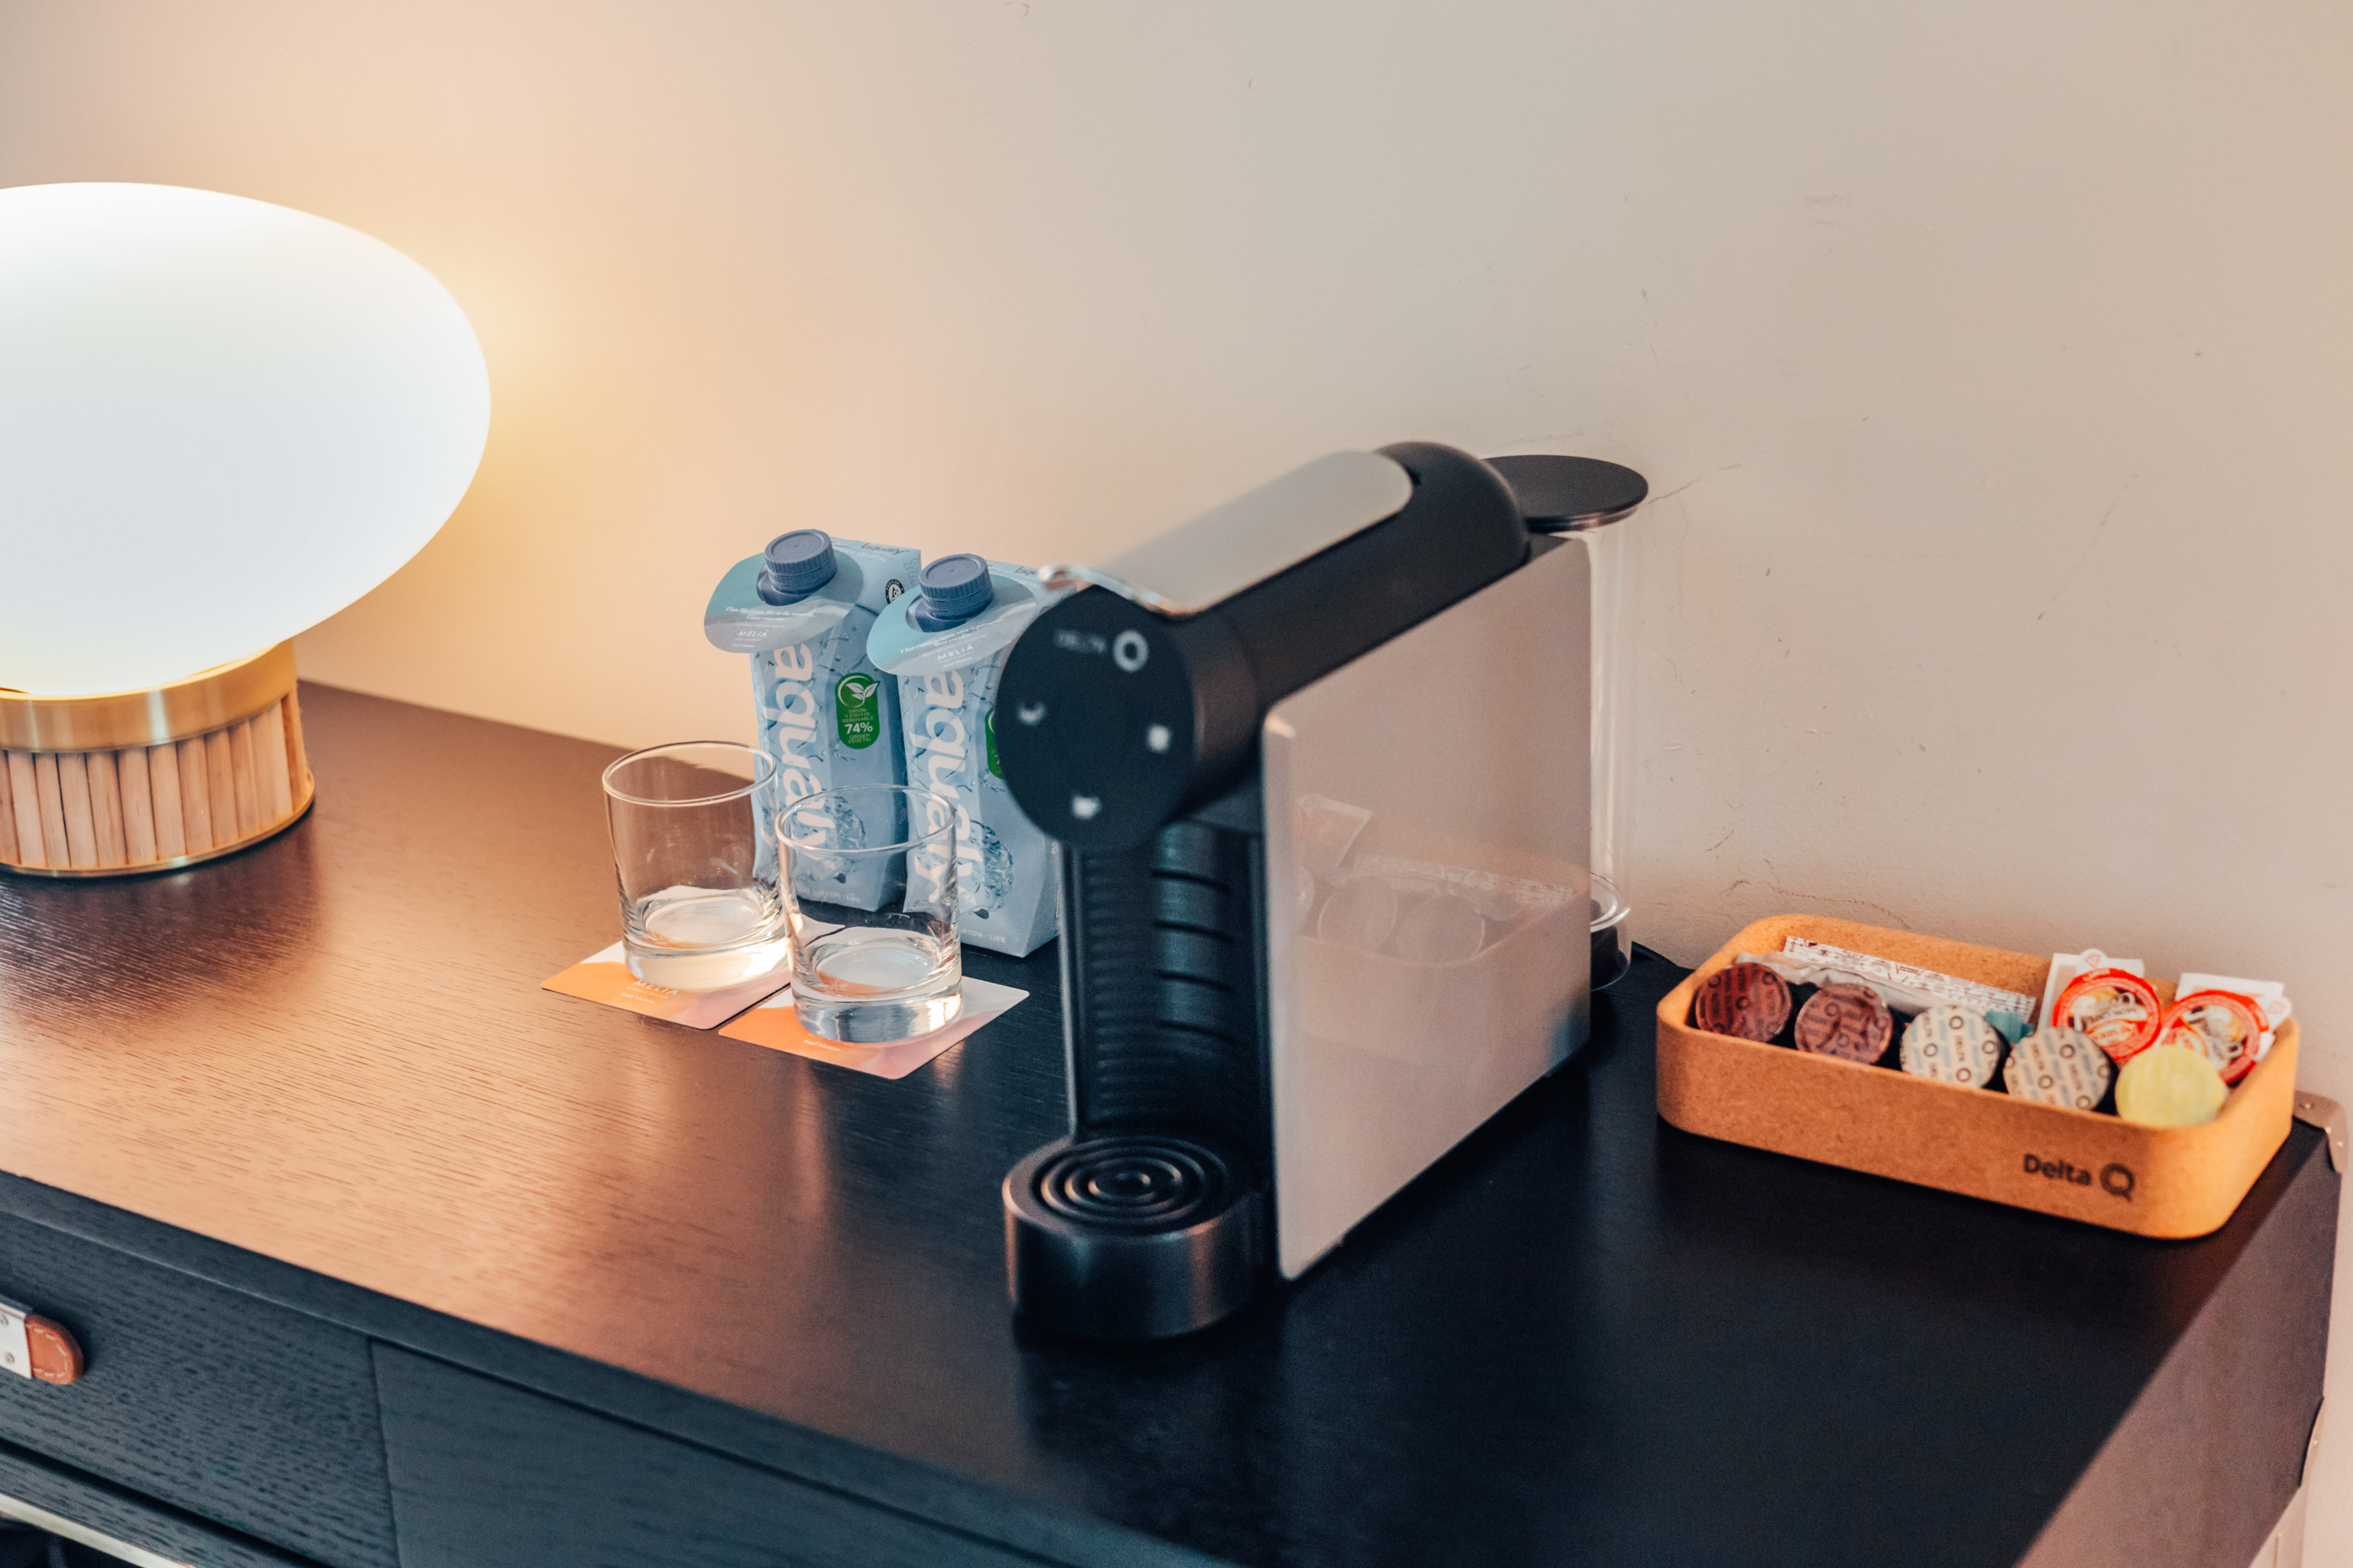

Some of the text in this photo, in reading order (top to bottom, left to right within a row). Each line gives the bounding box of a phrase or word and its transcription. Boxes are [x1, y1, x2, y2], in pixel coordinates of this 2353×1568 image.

[844, 722, 873, 734] 74%
[960, 928, 1006, 943] ARTON LIFE
[2024, 1153, 2135, 1202] Delta Q
